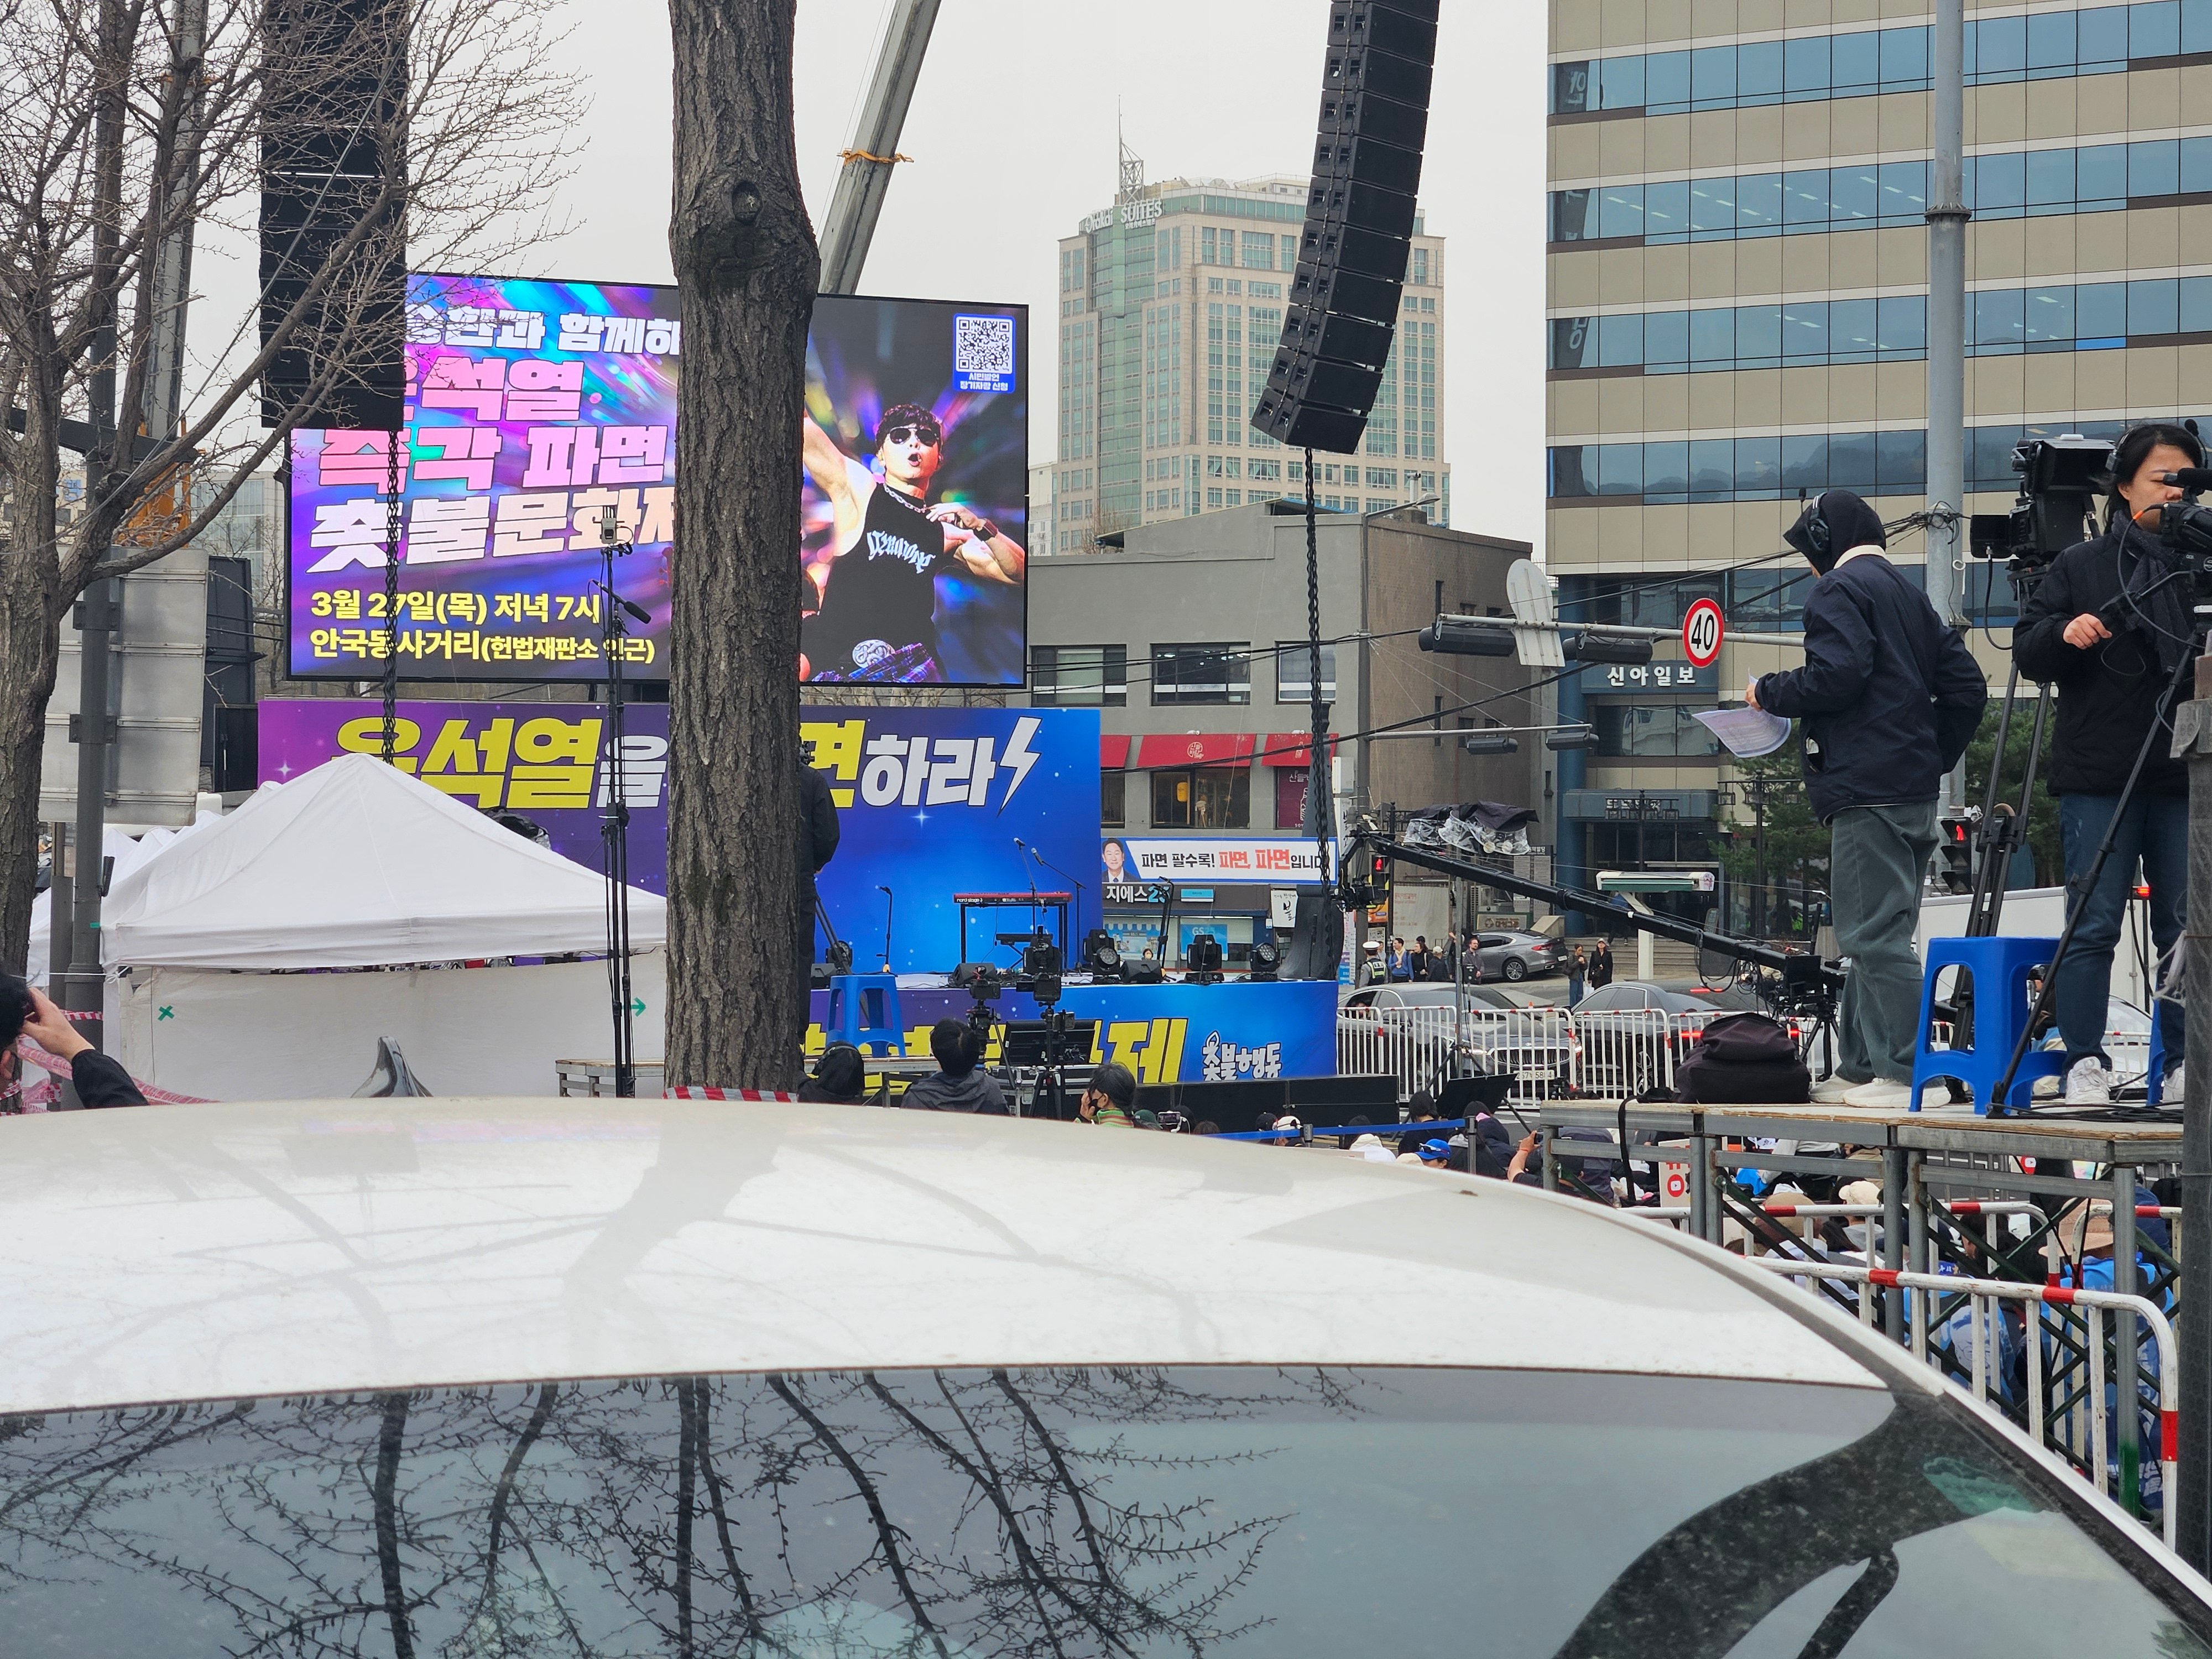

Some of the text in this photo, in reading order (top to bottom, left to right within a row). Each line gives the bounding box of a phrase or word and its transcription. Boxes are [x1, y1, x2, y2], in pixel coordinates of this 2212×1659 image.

[1120, 200, 1162, 223] SUITES
[319, 425, 667, 494] 즉각 파면
[311, 589, 600, 624] 3월 27일(목) 저녁 7시
[310, 627, 391, 659] 안국동
[603, 638, 655, 664] 인근)
[1691, 614, 1715, 651] 40
[1607, 666, 1695, 687] 신아일보
[1141, 853, 1168, 868] 파면
[1172, 853, 1215, 868] 팔수록!
[1202, 1031, 1282, 1081] 촛불행동
